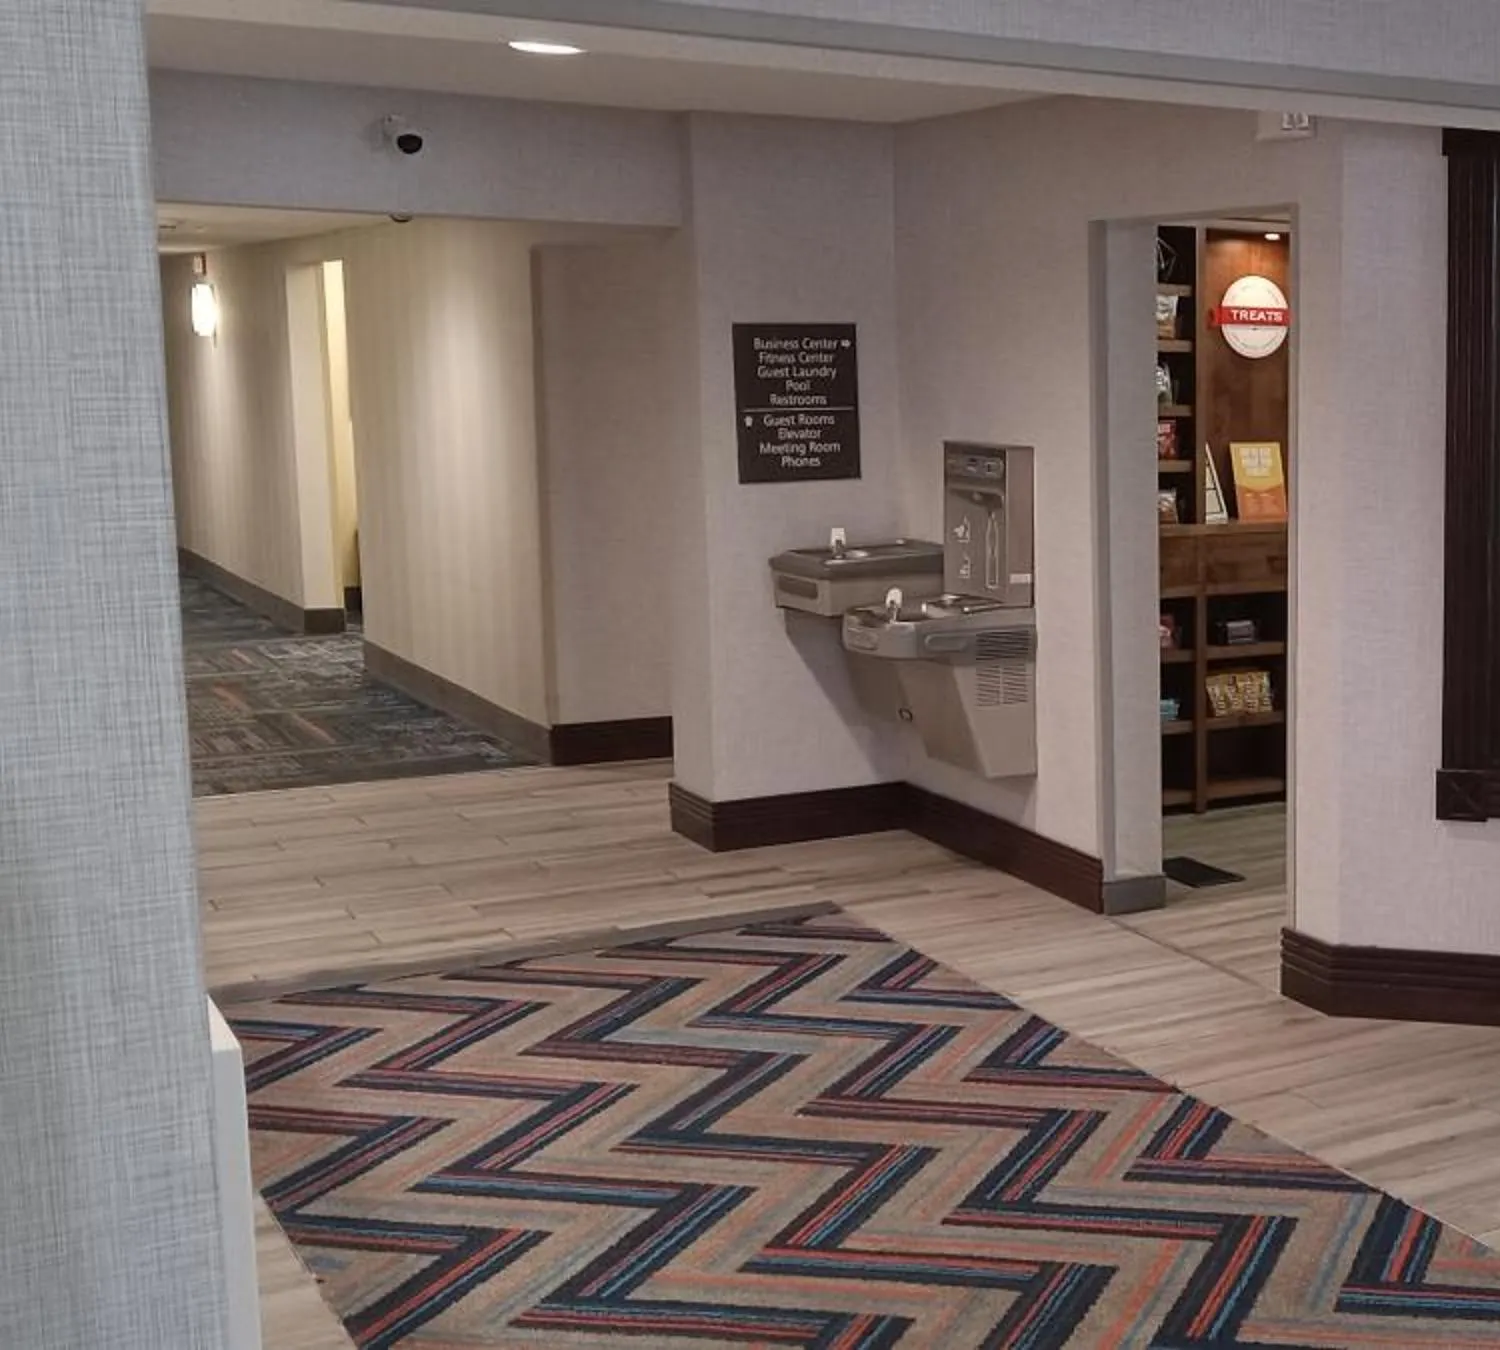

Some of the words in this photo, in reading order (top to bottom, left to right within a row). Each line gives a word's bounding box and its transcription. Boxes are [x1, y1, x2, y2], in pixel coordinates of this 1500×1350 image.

[1231, 310, 1283, 322] TREATS
[753, 337, 799, 350] Business
[802, 337, 838, 349] Center
[759, 352, 796, 364] Fitness
[799, 351, 834, 363] Center
[757, 365, 789, 378] Guest
[792, 365, 837, 380] Laundry
[785, 380, 811, 391] Pool
[769, 393, 828, 405] Restrooms
[763, 414, 796, 427] Guest
[798, 414, 835, 425] Rooms
[777, 427, 822, 440] Elevator
[759, 442, 806, 456] Meeting
[809, 441, 841, 453] Room
[781, 456, 821, 467] Phones
